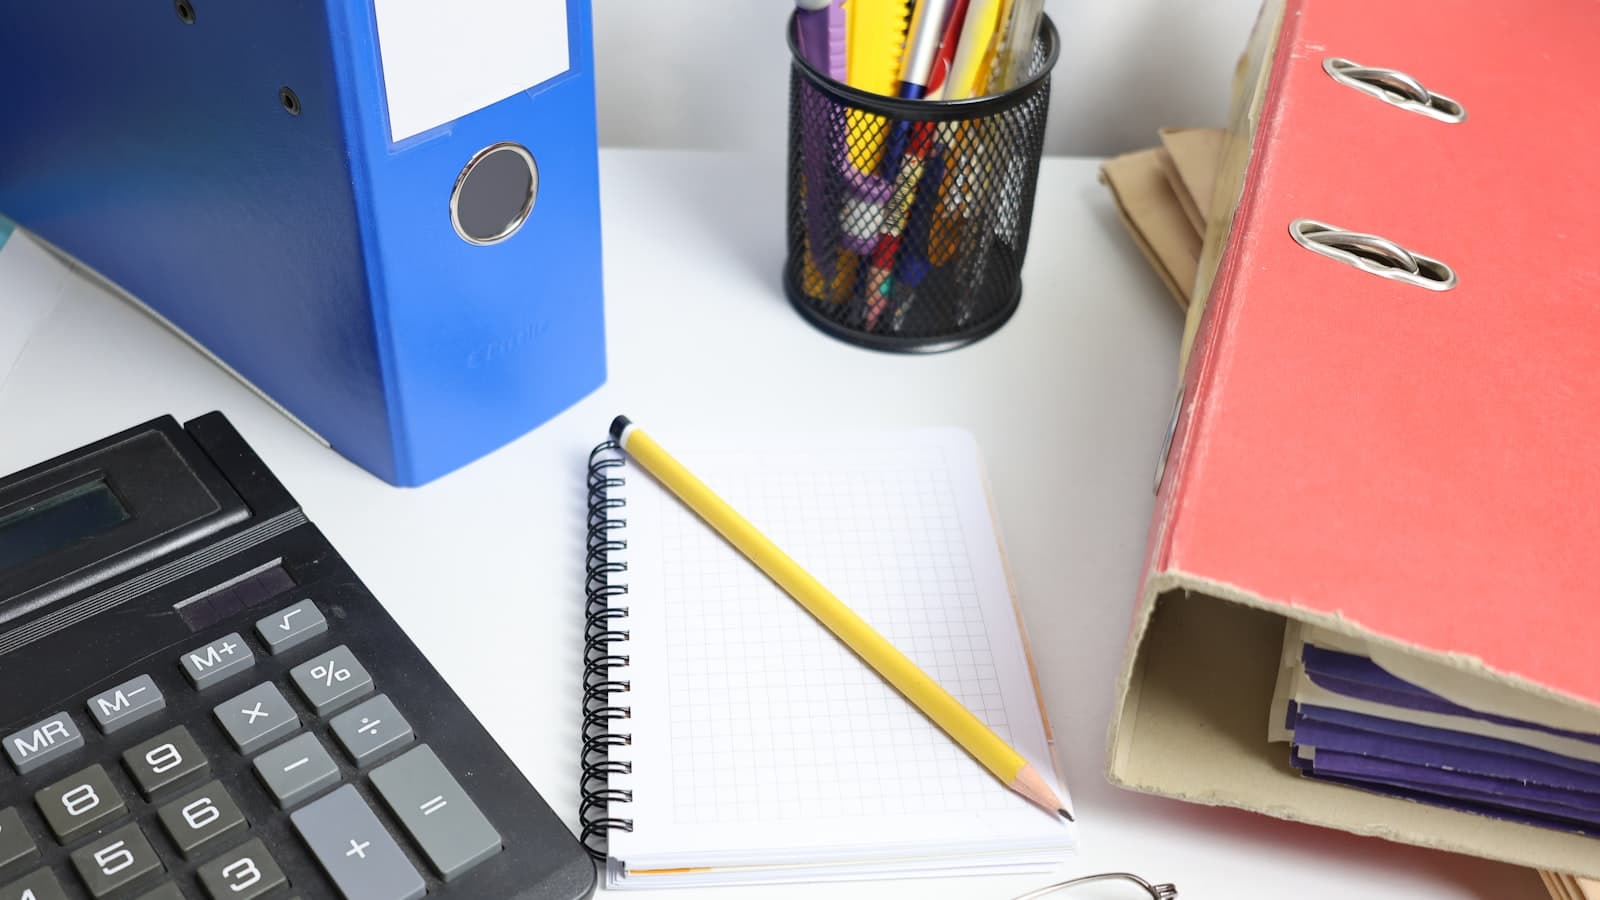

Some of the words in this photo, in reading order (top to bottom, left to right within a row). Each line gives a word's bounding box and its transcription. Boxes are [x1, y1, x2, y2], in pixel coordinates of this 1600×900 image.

[189, 641, 238, 672] M+
[309, 660, 352, 687] %
[96, 686, 147, 716] M-
[13, 720, 71, 757] MR
[145, 743, 183, 774] 9
[61, 784, 100, 816] 8
[182, 797, 220, 829] 6
[93, 840, 134, 875] 5
[222, 857, 261, 892] 3
